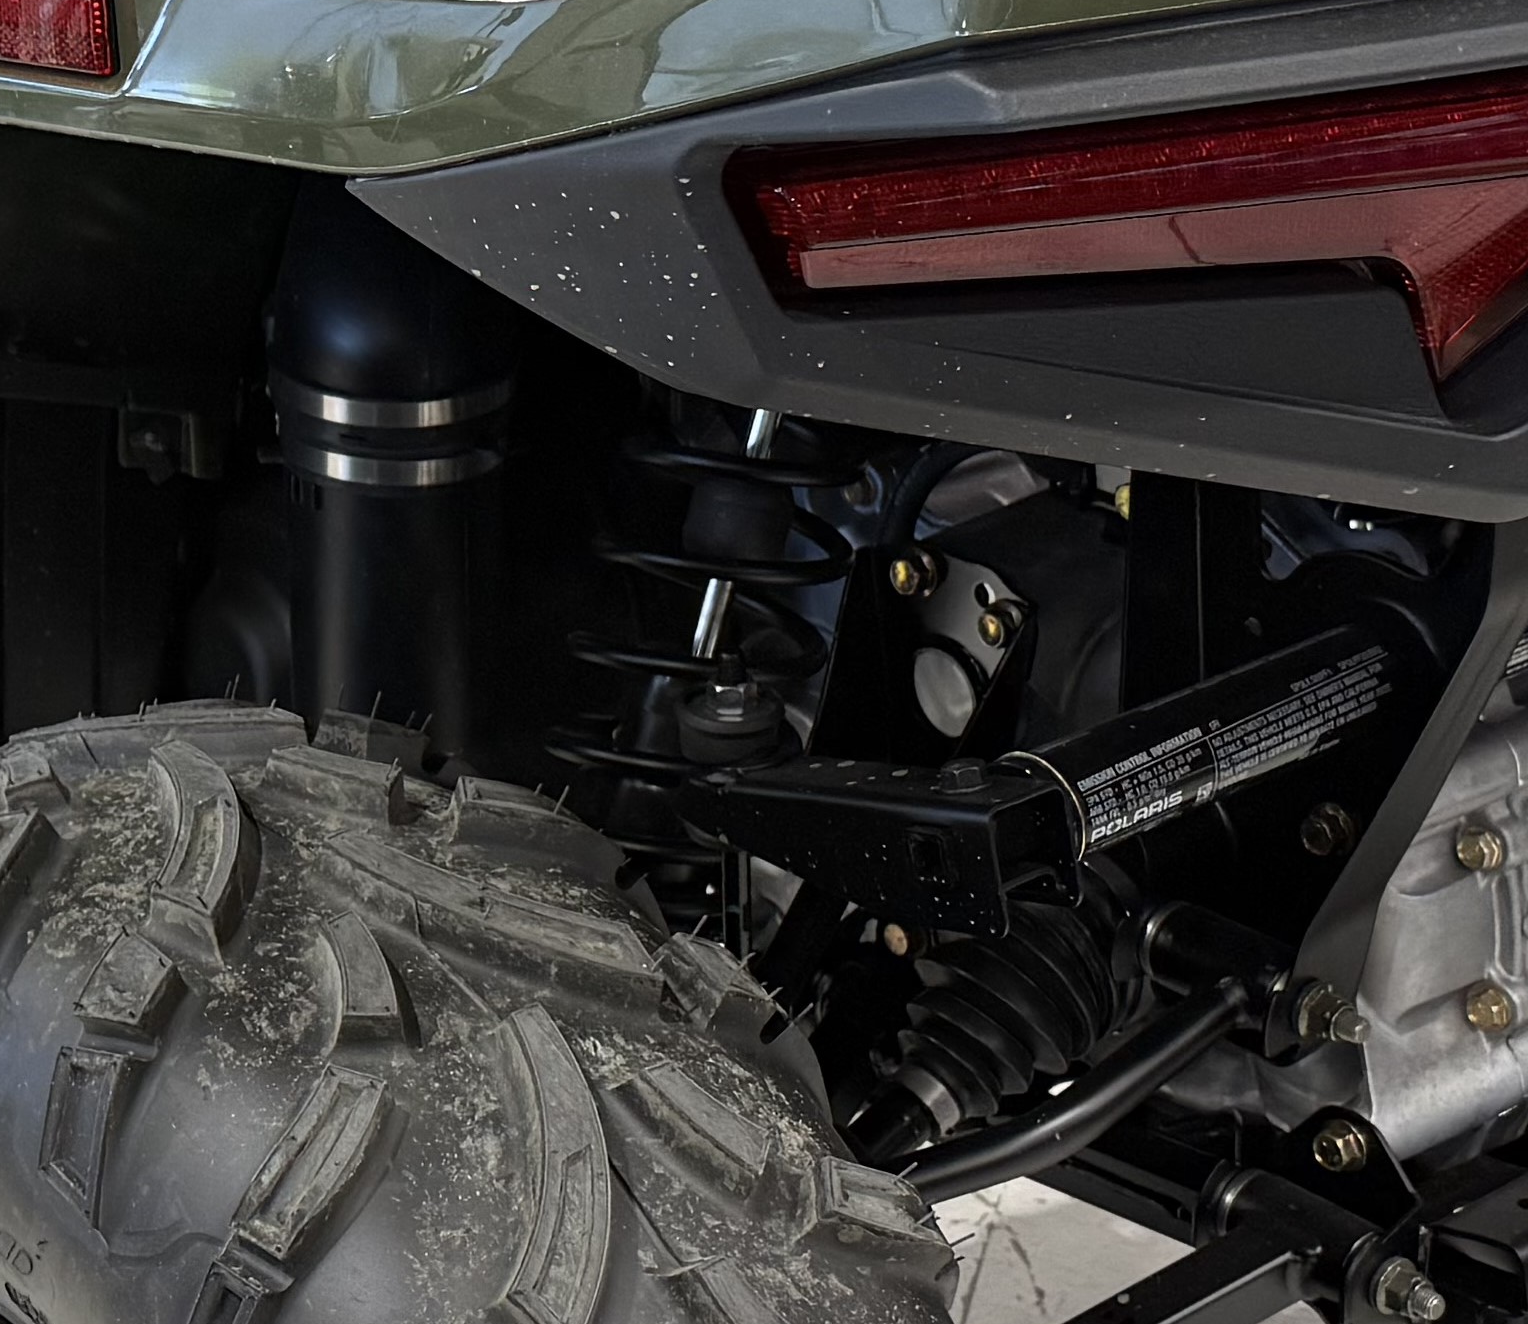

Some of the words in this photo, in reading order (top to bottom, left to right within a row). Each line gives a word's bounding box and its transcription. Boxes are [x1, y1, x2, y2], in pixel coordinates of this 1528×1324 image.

[1077, 767, 1116, 791] EMISSION
[1115, 752, 1151, 773] CONTROL
[1150, 727, 1202, 757] INFORMATION
[1090, 792, 1184, 843] POLARIS
